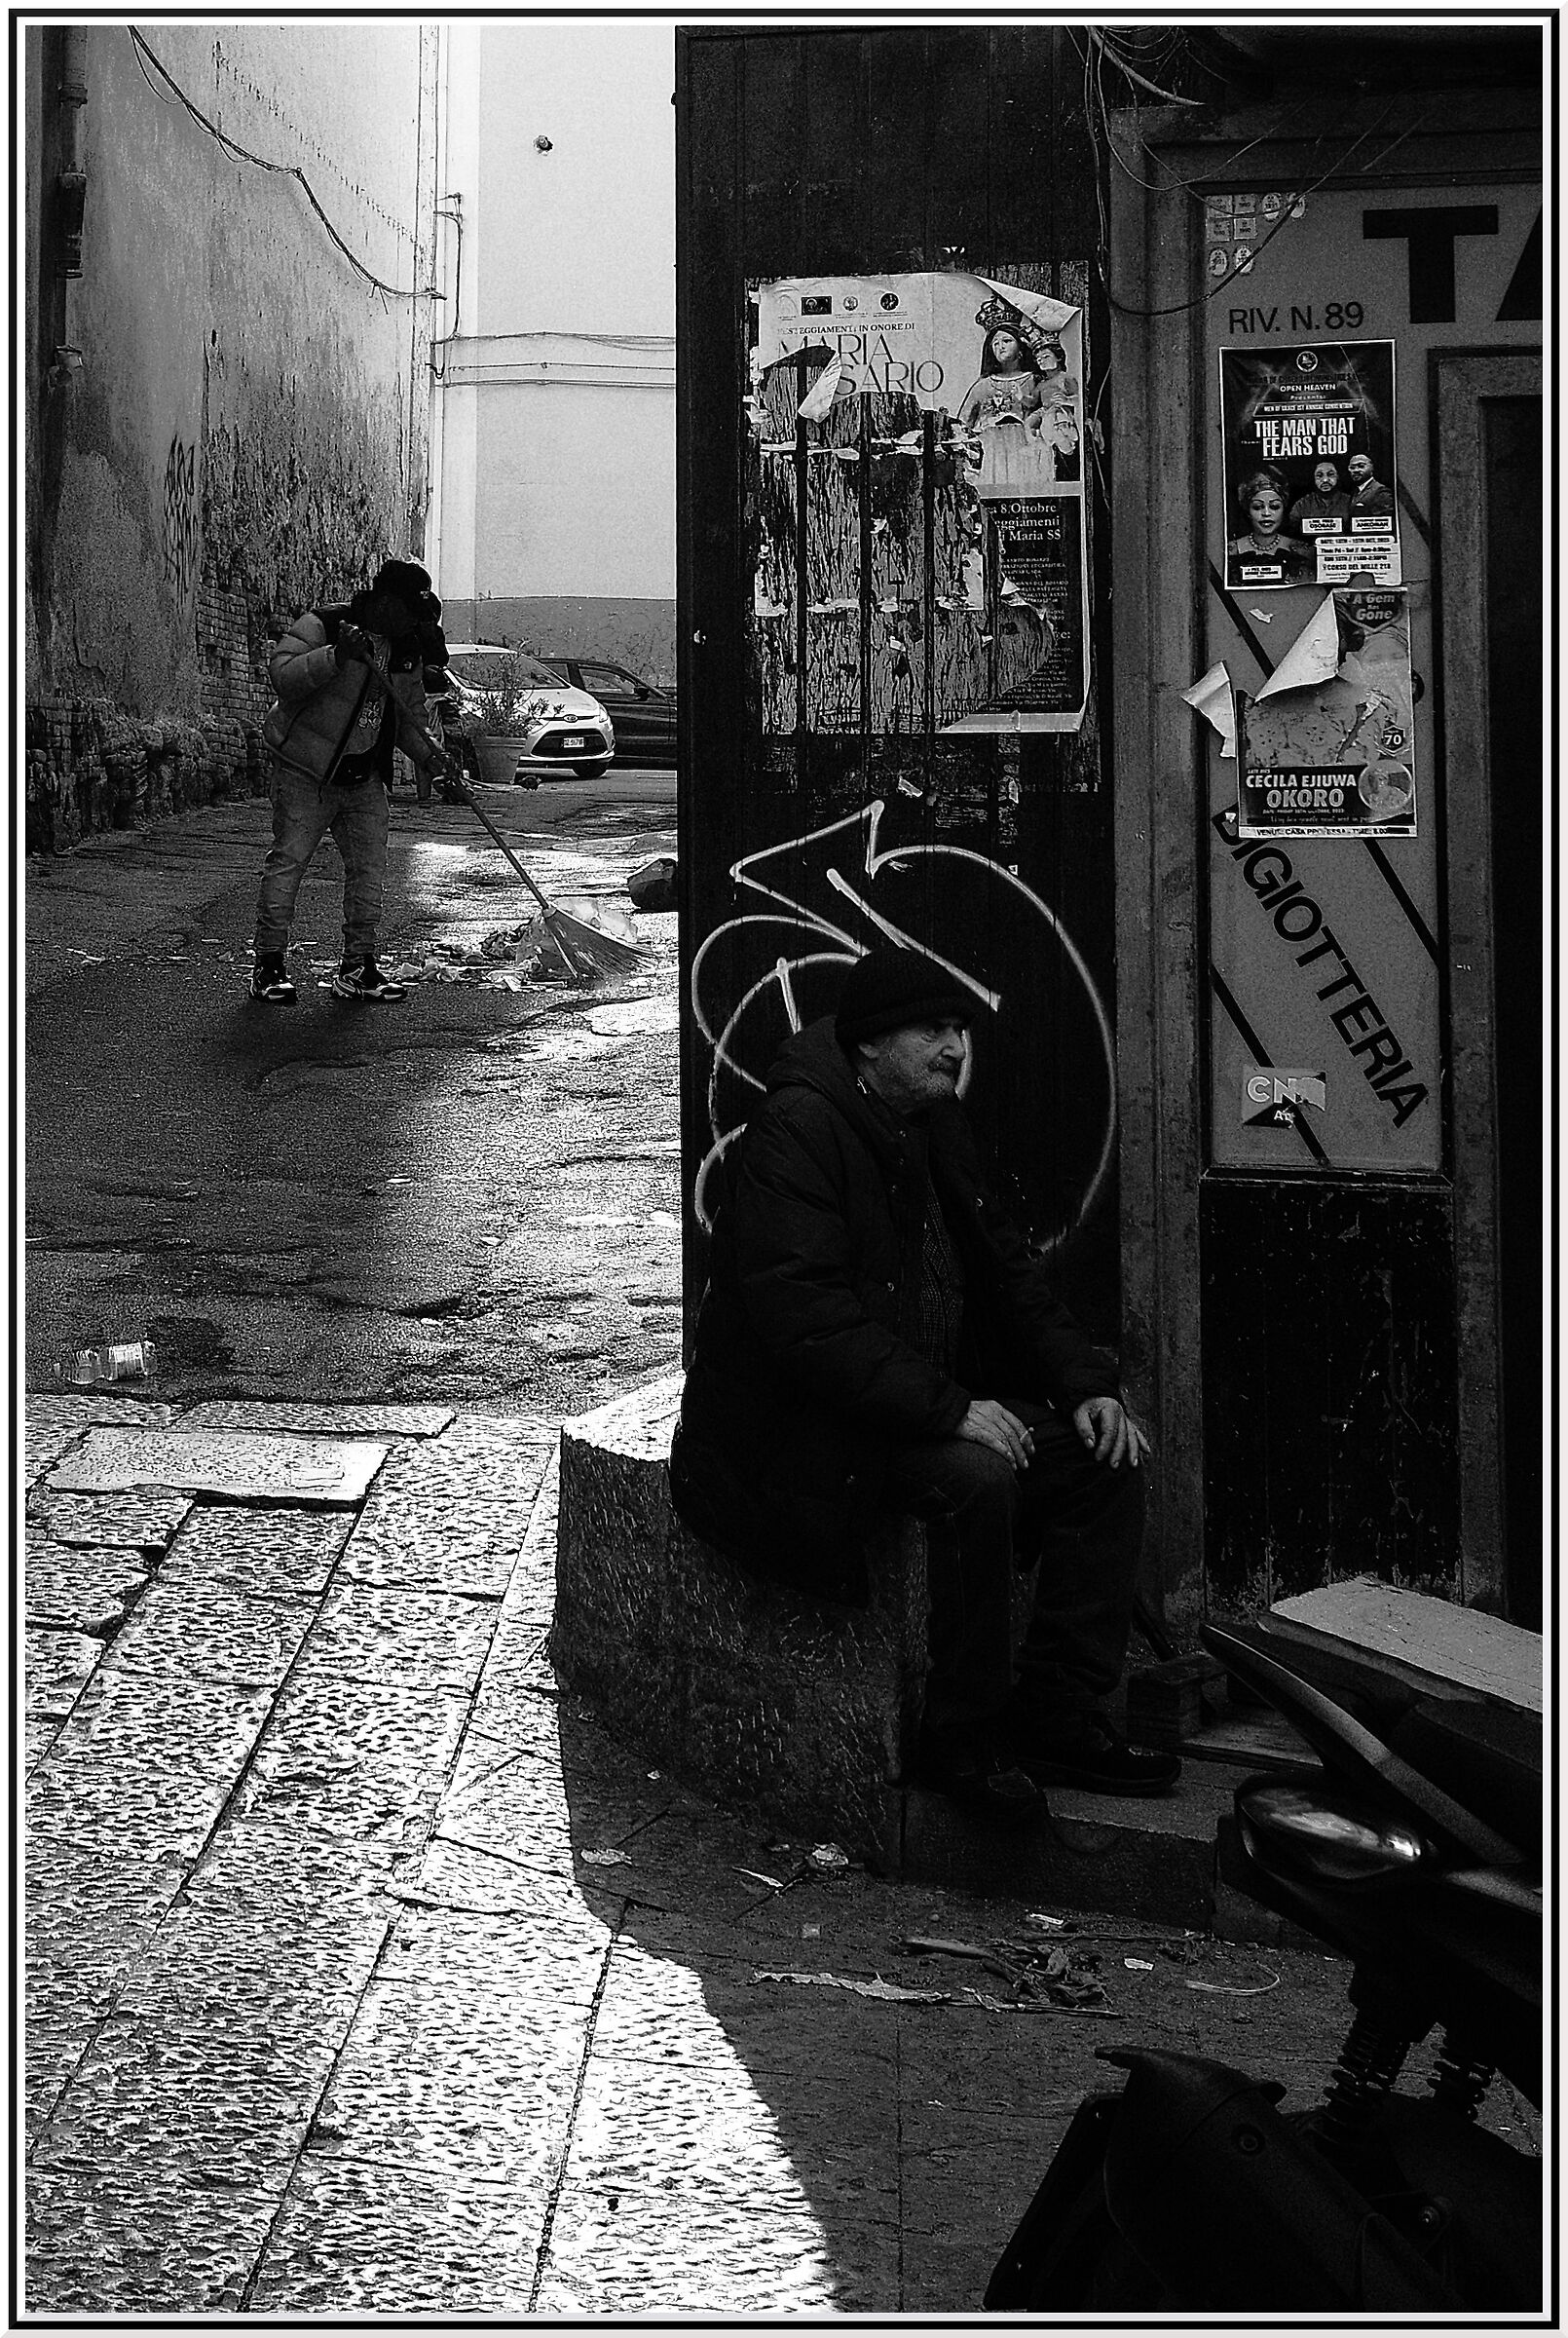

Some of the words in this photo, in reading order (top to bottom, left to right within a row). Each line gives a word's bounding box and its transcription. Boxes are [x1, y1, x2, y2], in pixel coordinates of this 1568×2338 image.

[1229, 308, 1281, 334] RIV.
[1291, 306, 1319, 331] N.
[1325, 302, 1363, 329] 89
[859, 323, 869, 332] IN
[871, 322, 904, 331] ONORE
[905, 321, 915, 330] DI
[1254, 420, 1280, 437] THE
[1283, 419, 1316, 436] MAN
[1320, 417, 1356, 434] THAT
[1262, 436, 1313, 457] FEARS
[1318, 434, 1348, 455] GOD
[1011, 502, 1058, 514] Ottobre
[1009, 530, 1044, 542] Maria
[1047, 528, 1062, 541] SS
[1353, 593, 1363, 604] A
[1366, 593, 1396, 604] Gem
[1356, 608, 1394, 621] Gone
[1384, 735, 1402, 745] 70
[1246, 774, 1298, 788] CECILA
[1301, 774, 1358, 787] EJIUWA
[1266, 788, 1344, 809] OKORO
